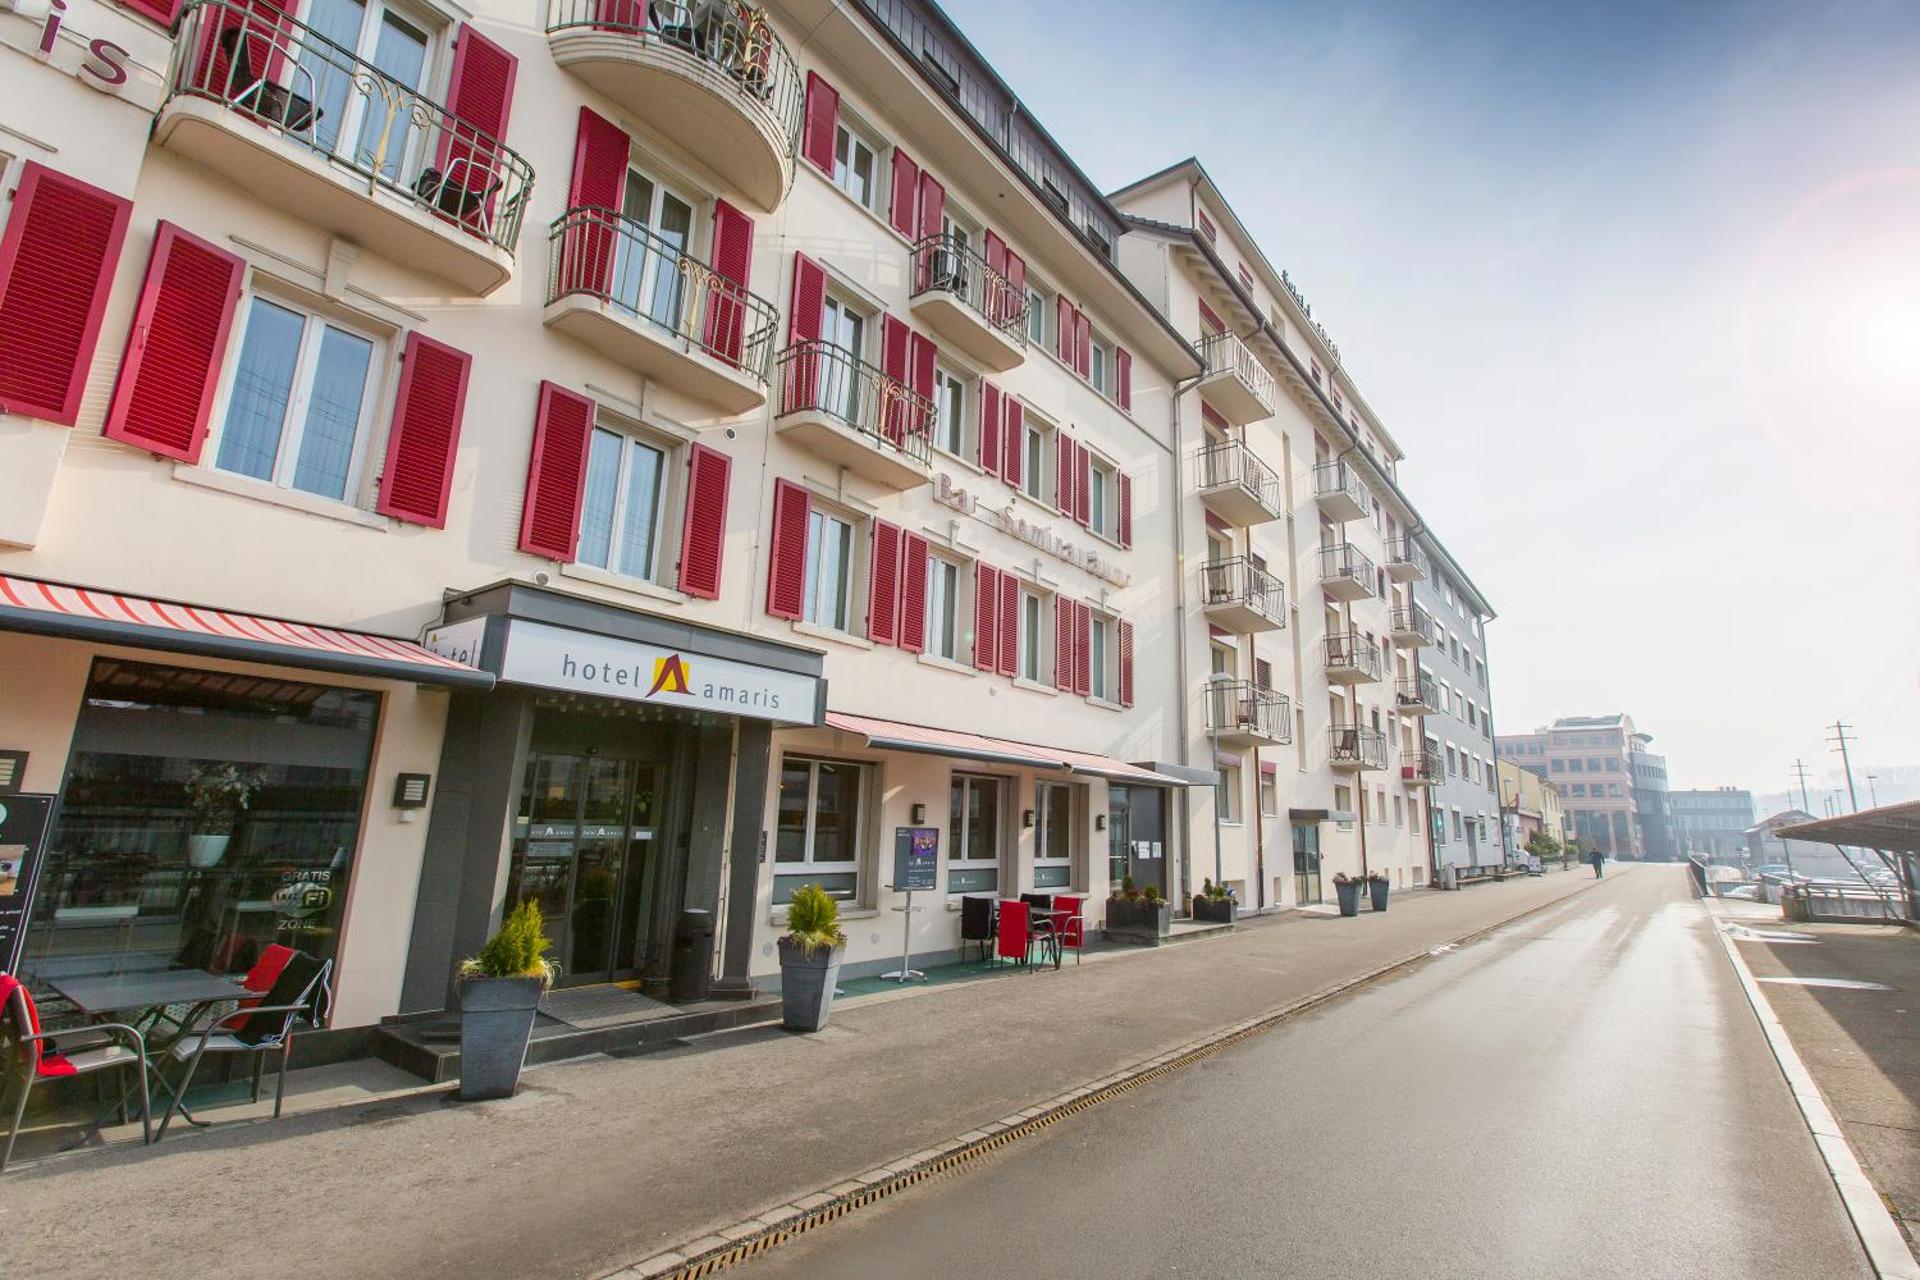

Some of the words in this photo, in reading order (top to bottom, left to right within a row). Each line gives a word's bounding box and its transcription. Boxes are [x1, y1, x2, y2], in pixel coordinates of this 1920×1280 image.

[38, 0, 129, 86] is
[934, 473, 979, 514] Bar
[562, 653, 640, 688] hotel
[703, 682, 780, 709] amaris
[281, 870, 331, 881] GRATIS
[277, 919, 316, 930] ZONE
